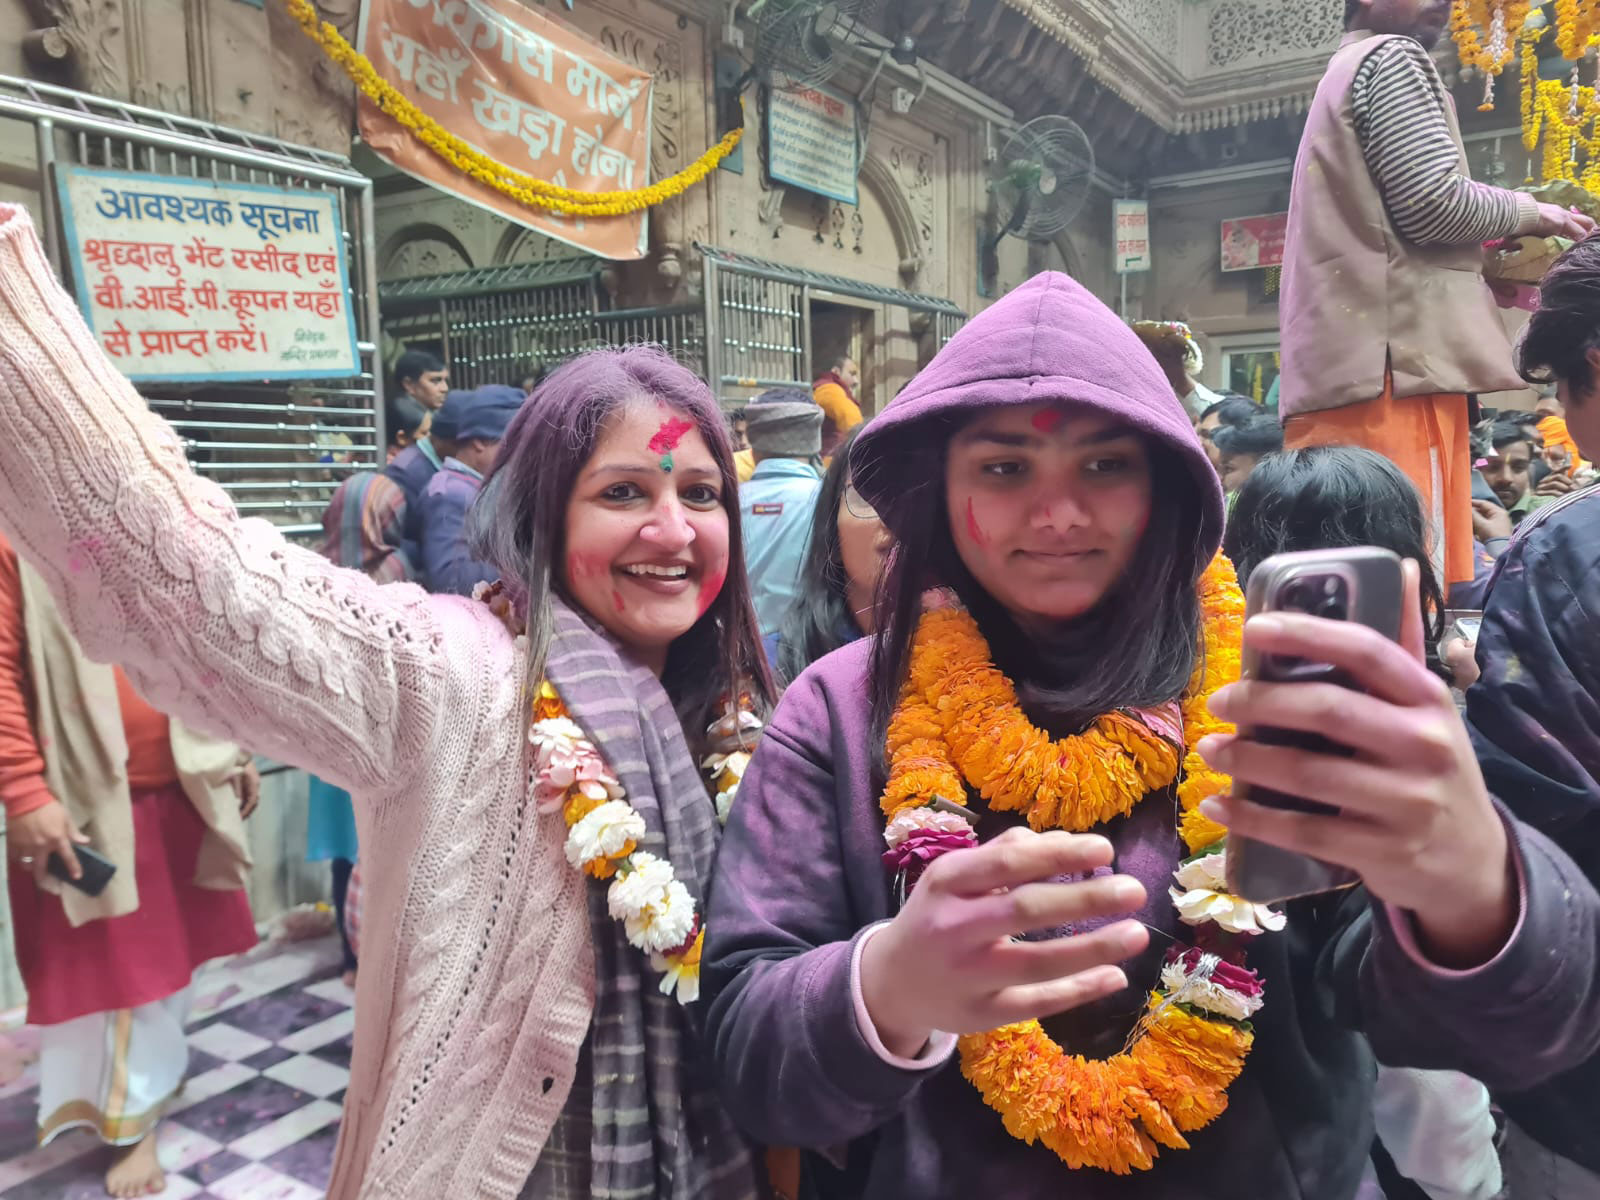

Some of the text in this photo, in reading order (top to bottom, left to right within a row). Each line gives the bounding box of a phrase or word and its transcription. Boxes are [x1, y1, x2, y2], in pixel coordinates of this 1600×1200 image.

[408, 0, 553, 84] कास
[472, 78, 566, 160] खड़ा
[571, 124, 636, 190] होना
[96, 188, 320, 241] आवश्यक सूचना
[182, 236, 224, 269] भेंट
[231, 243, 302, 279] रसीद
[304, 245, 336, 274] एवं
[293, 278, 341, 319] यहाँ
[101, 319, 132, 358] से
[137, 329, 209, 358] प्राप्त
